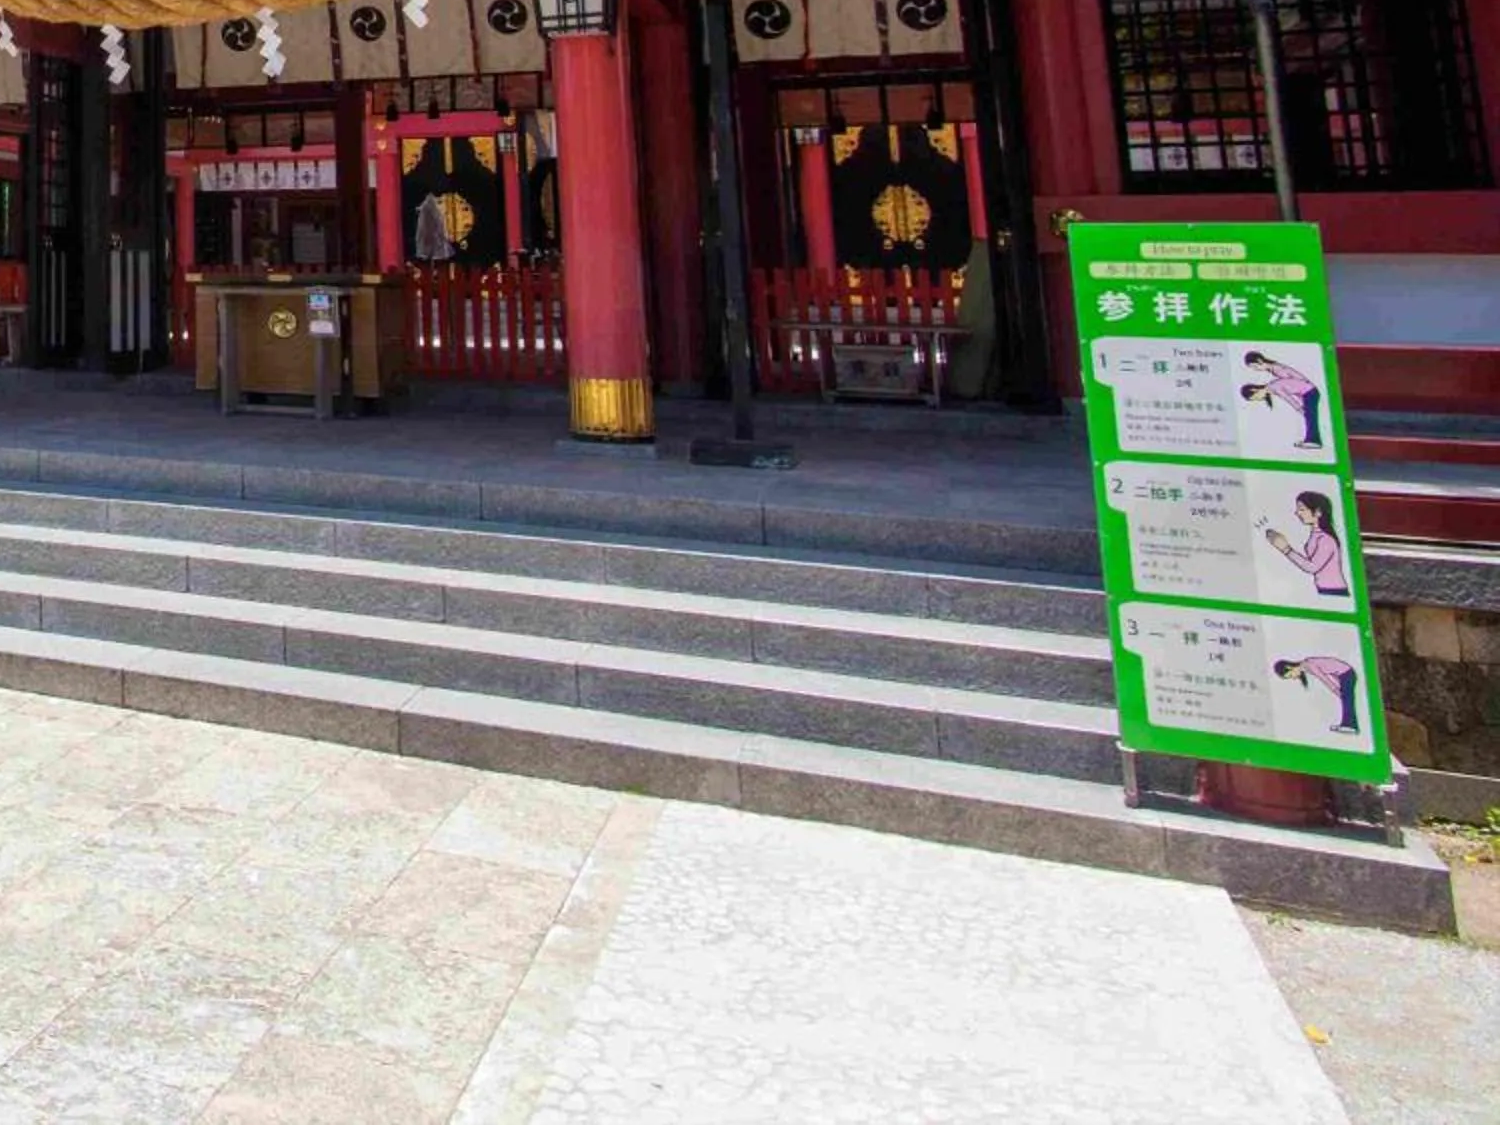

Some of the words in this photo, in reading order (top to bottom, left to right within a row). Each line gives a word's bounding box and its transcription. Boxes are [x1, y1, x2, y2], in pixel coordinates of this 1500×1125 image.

[1096, 290, 1307, 326] 参拝作法
[1100, 352, 1107, 368] 1
[1111, 478, 1124, 494] 2
[1127, 619, 1139, 636] 3
